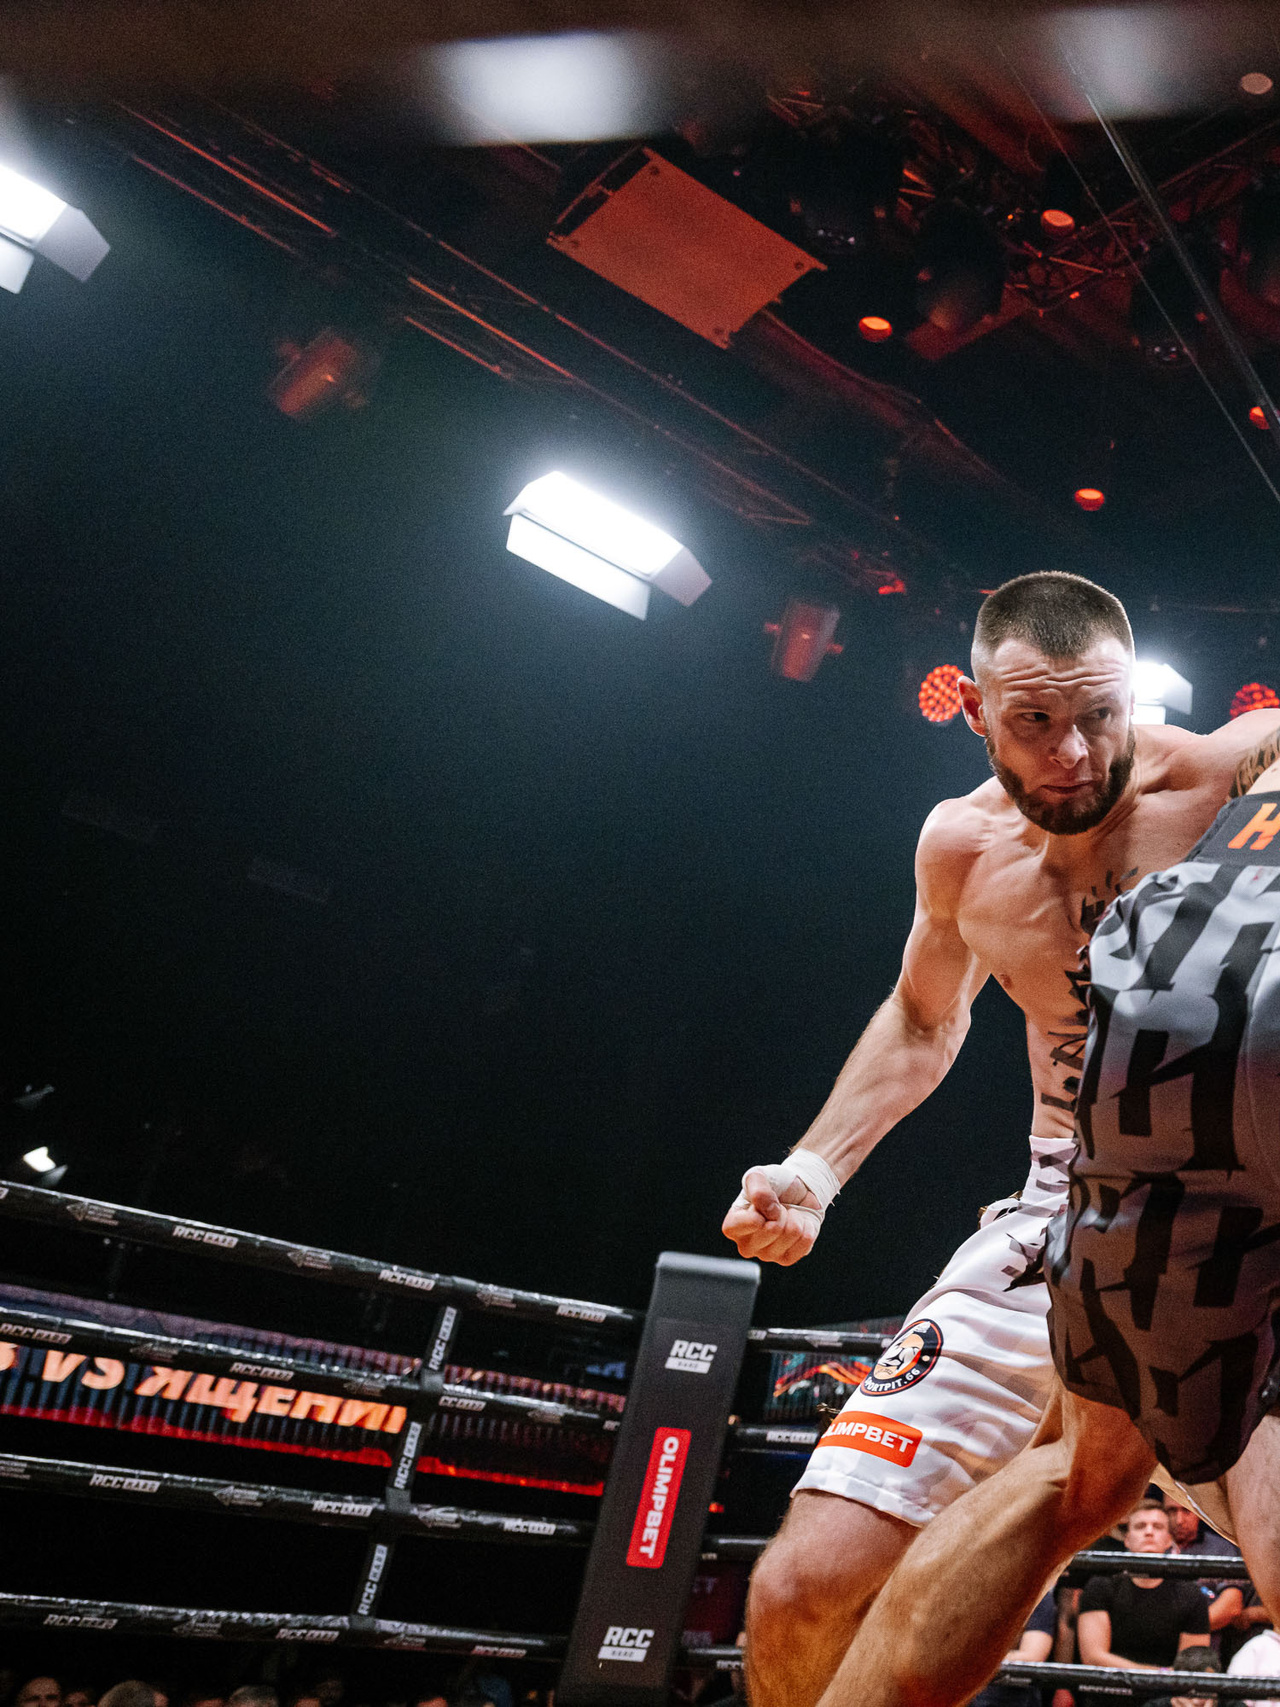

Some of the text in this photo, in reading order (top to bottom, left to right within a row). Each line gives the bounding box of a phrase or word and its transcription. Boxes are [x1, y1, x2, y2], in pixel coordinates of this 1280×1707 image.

[173, 1224, 204, 1241] RCC
[428, 1339, 446, 1371] RCC
[669, 1339, 718, 1362] RCC
[229, 1362, 263, 1378] RCC
[89, 1473, 125, 1489] RCC
[393, 1456, 414, 1489] RCC
[639, 1436, 679, 1559] OLIMPBET
[356, 1581, 378, 1615] RCC
[43, 1613, 80, 1628] RCC
[602, 1625, 655, 1648] RCC
